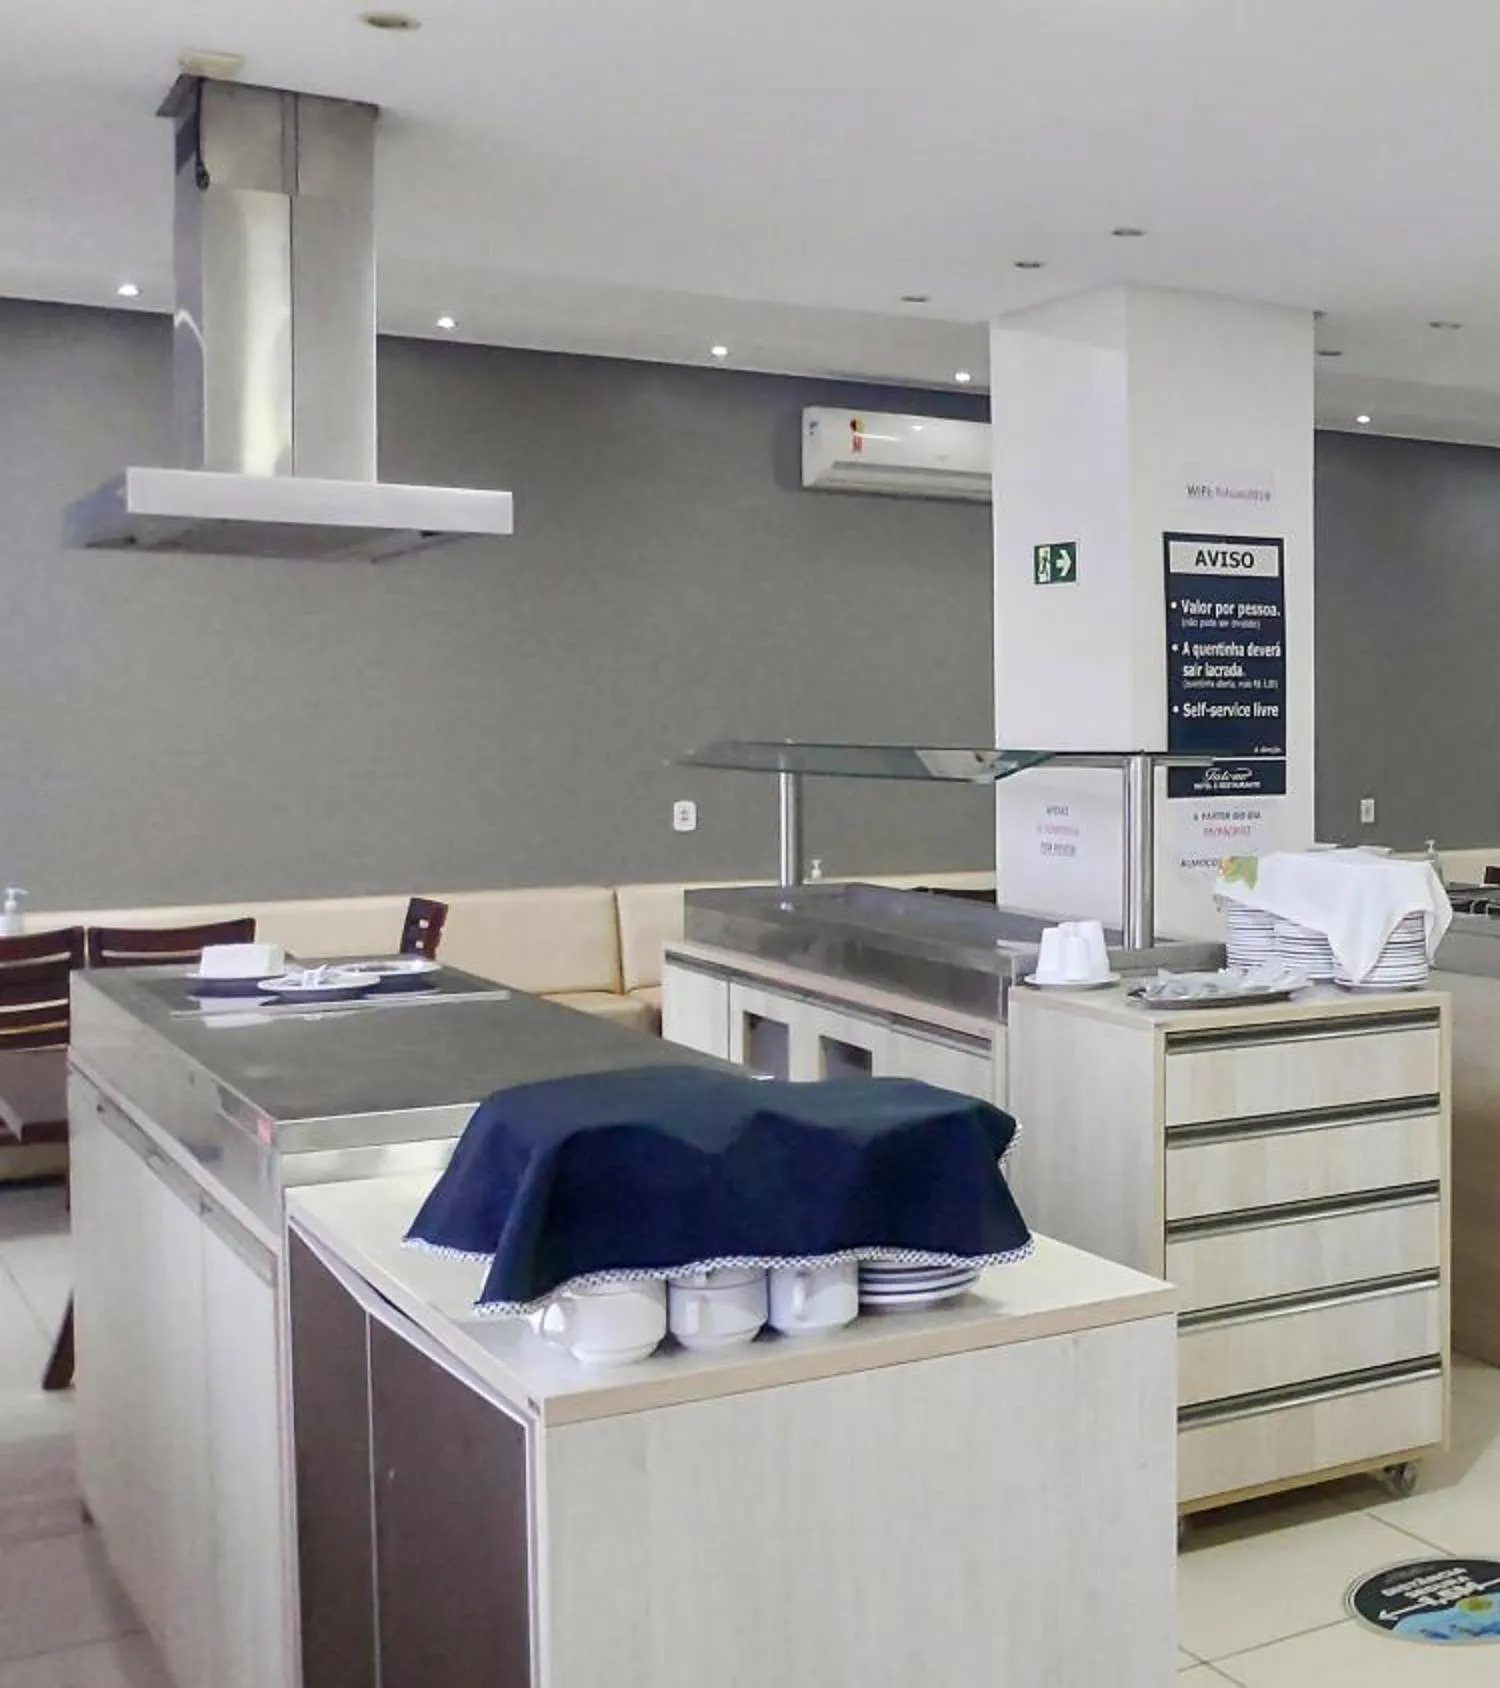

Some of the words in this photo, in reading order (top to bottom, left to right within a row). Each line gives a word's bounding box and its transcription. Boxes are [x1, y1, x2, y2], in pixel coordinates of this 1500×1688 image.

[1194, 550, 1255, 569] AVISO
[1181, 599, 1212, 615] Valor
[1215, 603, 1235, 618] por
[1238, 603, 1281, 618] pessoa.
[1182, 641, 1190, 656] A
[1192, 642, 1244, 660] quentinha
[1247, 641, 1281, 657] deverá
[1183, 663, 1203, 677] sair
[1205, 662, 1246, 677] lacrada.
[1183, 702, 1251, 718] Self-service
[1254, 702, 1280, 717] livre
